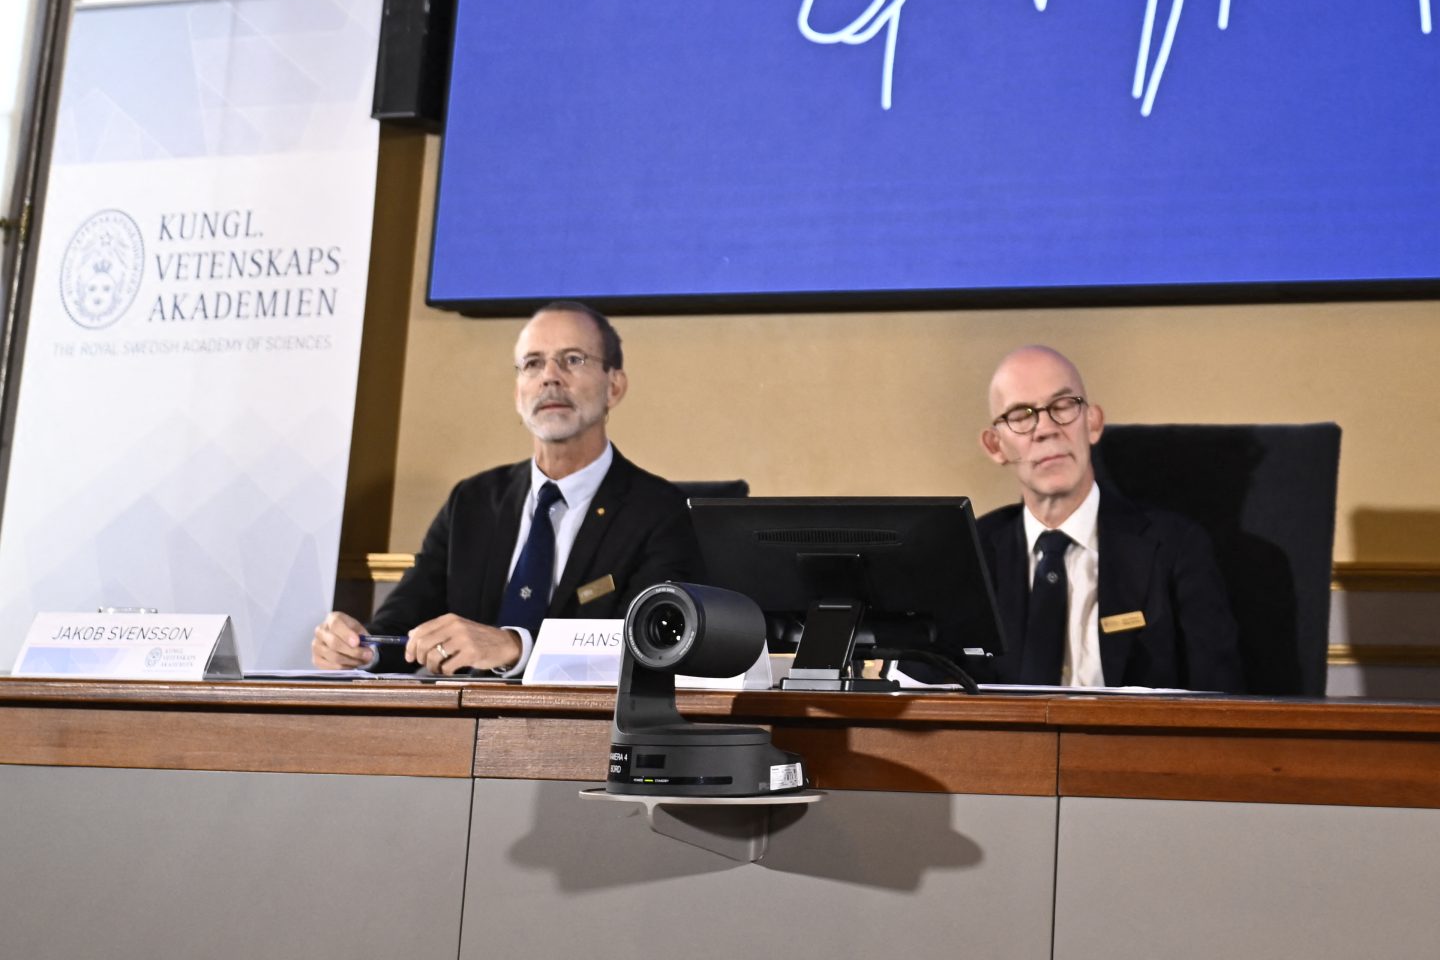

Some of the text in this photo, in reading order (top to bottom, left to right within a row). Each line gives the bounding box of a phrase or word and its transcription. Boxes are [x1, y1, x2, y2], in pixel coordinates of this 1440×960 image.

[158, 209, 264, 242] KUNGL.
[148, 287, 338, 323] AKADEMIEN
[80, 340, 117, 356] ROYAL
[123, 339, 179, 355] SWEDISH
[182, 337, 243, 353] ACADEMY
[246, 336, 262, 352] OF
[265, 334, 333, 351] SCIENCES
[52, 626, 194, 641] JAKOB SVENSSON
[571, 632, 621, 648] HANS
